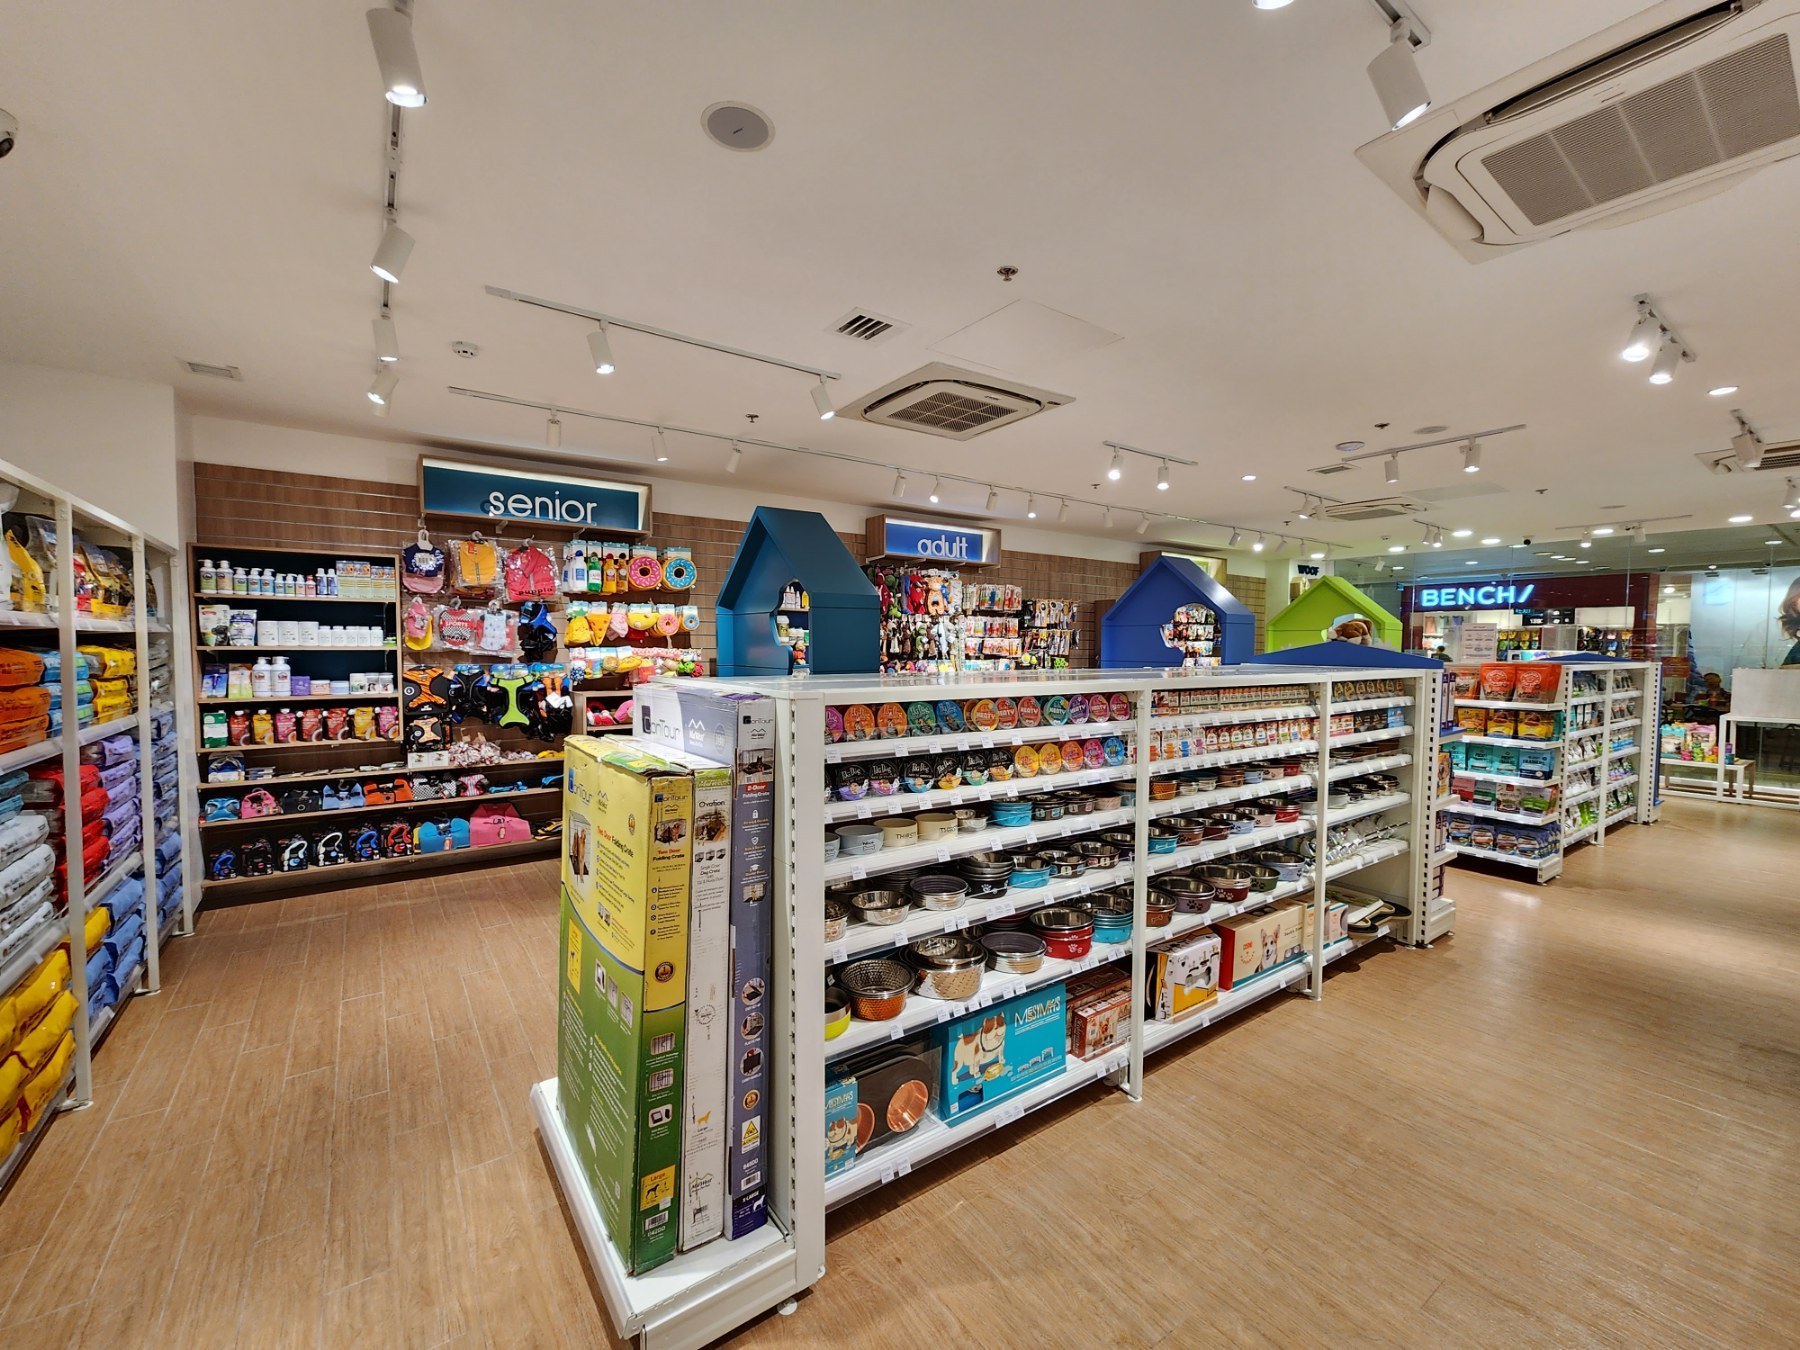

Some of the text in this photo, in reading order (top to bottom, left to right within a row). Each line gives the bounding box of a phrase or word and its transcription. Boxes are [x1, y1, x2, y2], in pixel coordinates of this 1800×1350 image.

[489, 490, 598, 524] senior
[917, 535, 968, 559] adult
[1297, 564, 1319, 576] WOOF
[699, 800, 726, 808] Ovation
[650, 1172, 666, 1182] Large
